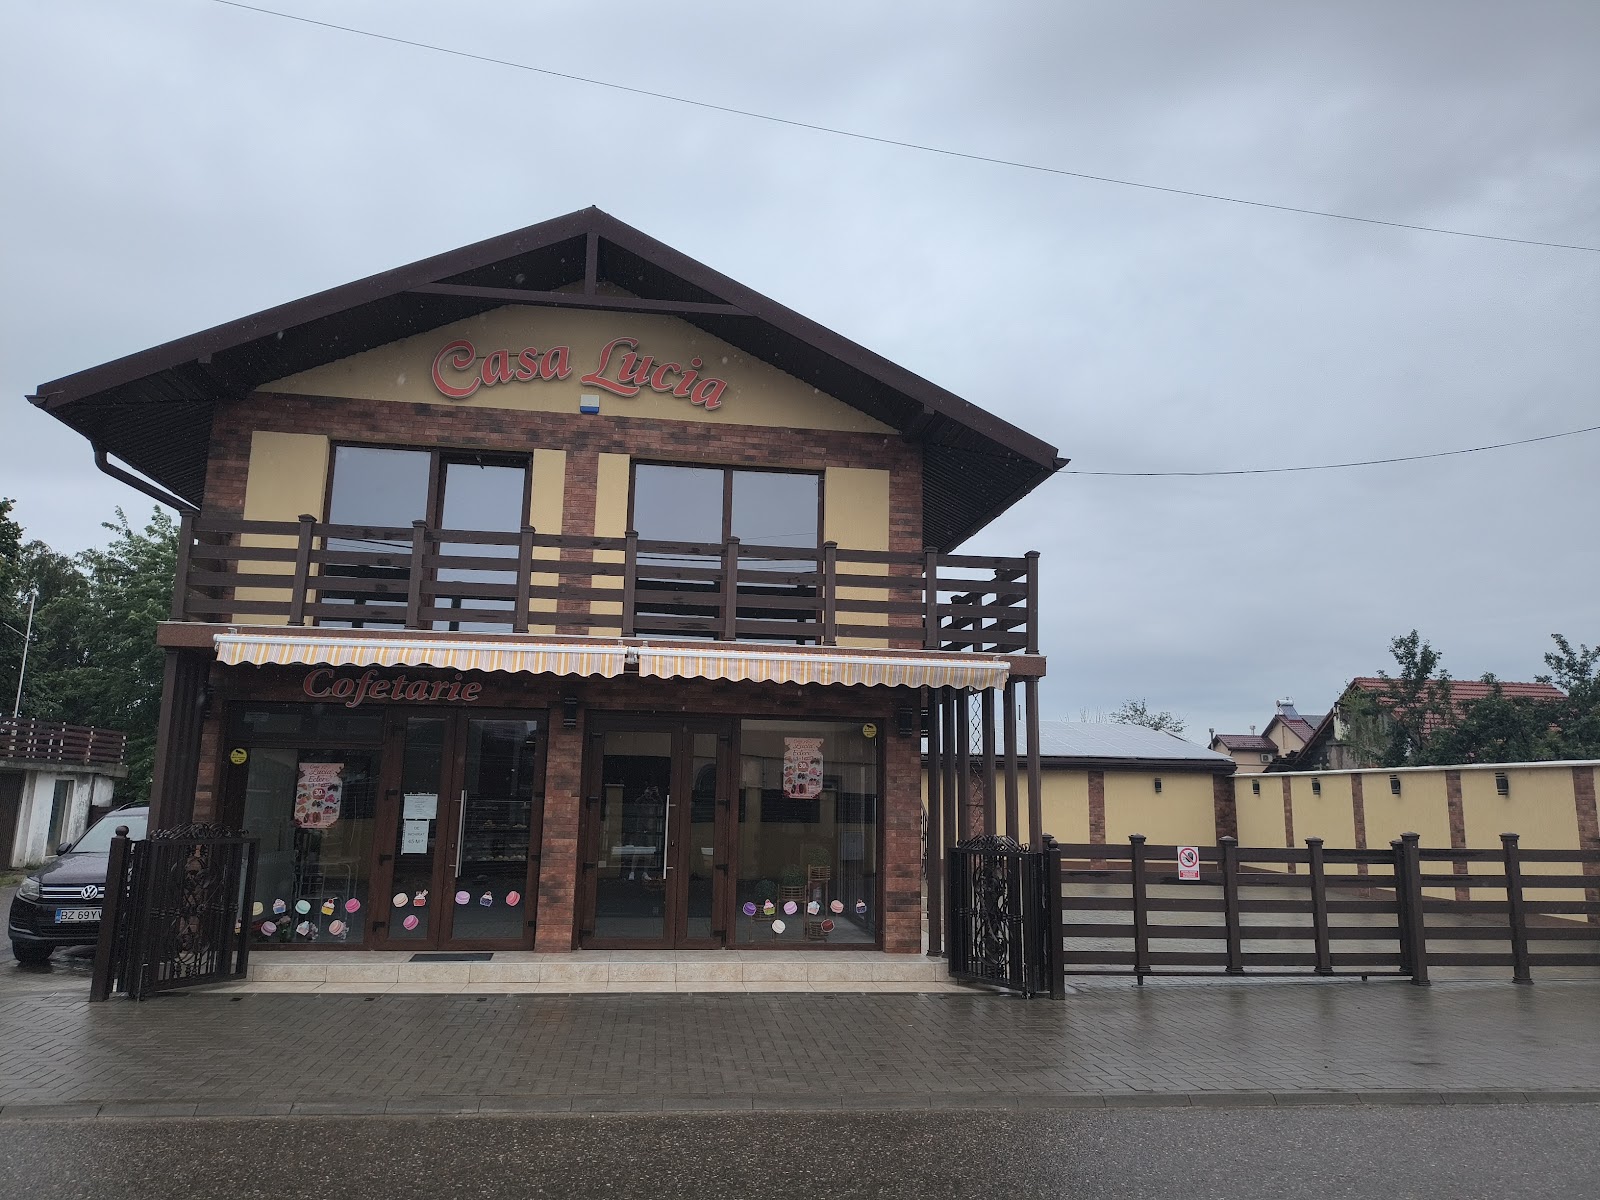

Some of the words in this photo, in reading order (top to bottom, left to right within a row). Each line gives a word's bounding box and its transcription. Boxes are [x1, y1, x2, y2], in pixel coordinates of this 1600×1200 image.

[431, 339, 572, 400] Casa
[580, 336, 728, 411] Lucia
[303, 668, 482, 708] Cofetarie
[60, 910, 75, 920] BZ
[77, 910, 90, 920] 69
